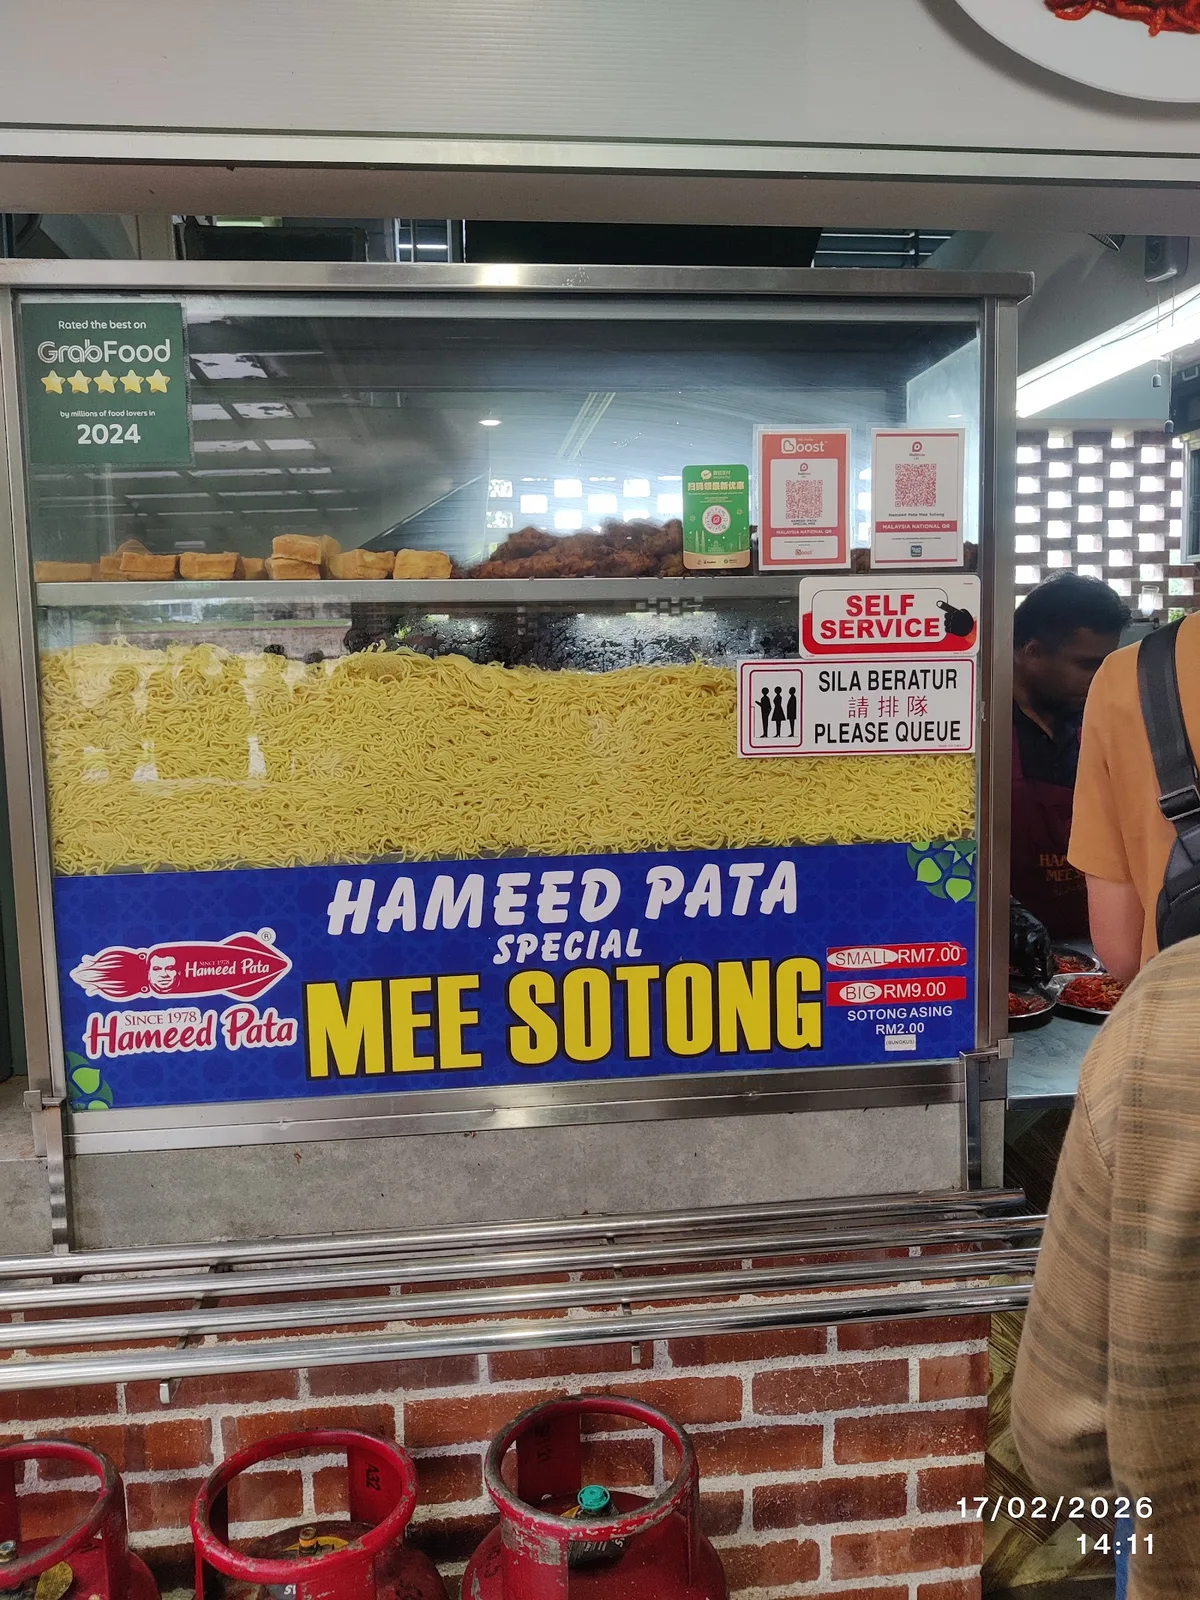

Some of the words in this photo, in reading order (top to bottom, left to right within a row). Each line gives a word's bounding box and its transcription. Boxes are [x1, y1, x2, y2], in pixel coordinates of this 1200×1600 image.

[58, 320, 89, 330] Rated
[90, 320, 108, 330] the
[109, 320, 132, 329] best
[133, 321, 147, 329] on
[37, 338, 171, 364] GrabFood
[60, 410, 70, 418] by
[99, 409, 107, 417] of
[108, 409, 125, 417] food
[126, 409, 148, 417] lovers
[77, 423, 141, 445] 2024
[846, 594, 914, 617] SELF
[820, 617, 940, 640] SERVICE
[818, 670, 861, 692] SILA
[868, 668, 958, 691] BERATUR
[848, 696, 928, 718] 請排隊
[814, 722, 889, 744] PLEASE
[895, 720, 961, 743] QUEUE
[327, 868, 621, 936] HAMEED
[645, 860, 798, 920] PATA
[493, 928, 643, 965] SPECIAL
[835, 951, 891, 966] SMALL
[898, 947, 961, 964] RM7.00
[185, 960, 237, 978] Hameed
[241, 958, 270, 975] Pata
[845, 985, 876, 1000] BIG
[884, 982, 947, 999] RM9.00
[125, 1013, 164, 1026] SINCE
[167, 1011, 197, 1024] 1978
[306, 973, 484, 1079] MEE
[508, 957, 822, 1066] SOTONG
[847, 1008, 907, 1022] SOTONG
[909, 1005, 953, 1018] ASING
[87, 1013, 214, 1055] Hameed
[225, 1007, 293, 1046] Pata
[875, 1022, 925, 1035] RM2.00
[886, 1038, 916, 1046] (BUNGKUS)
